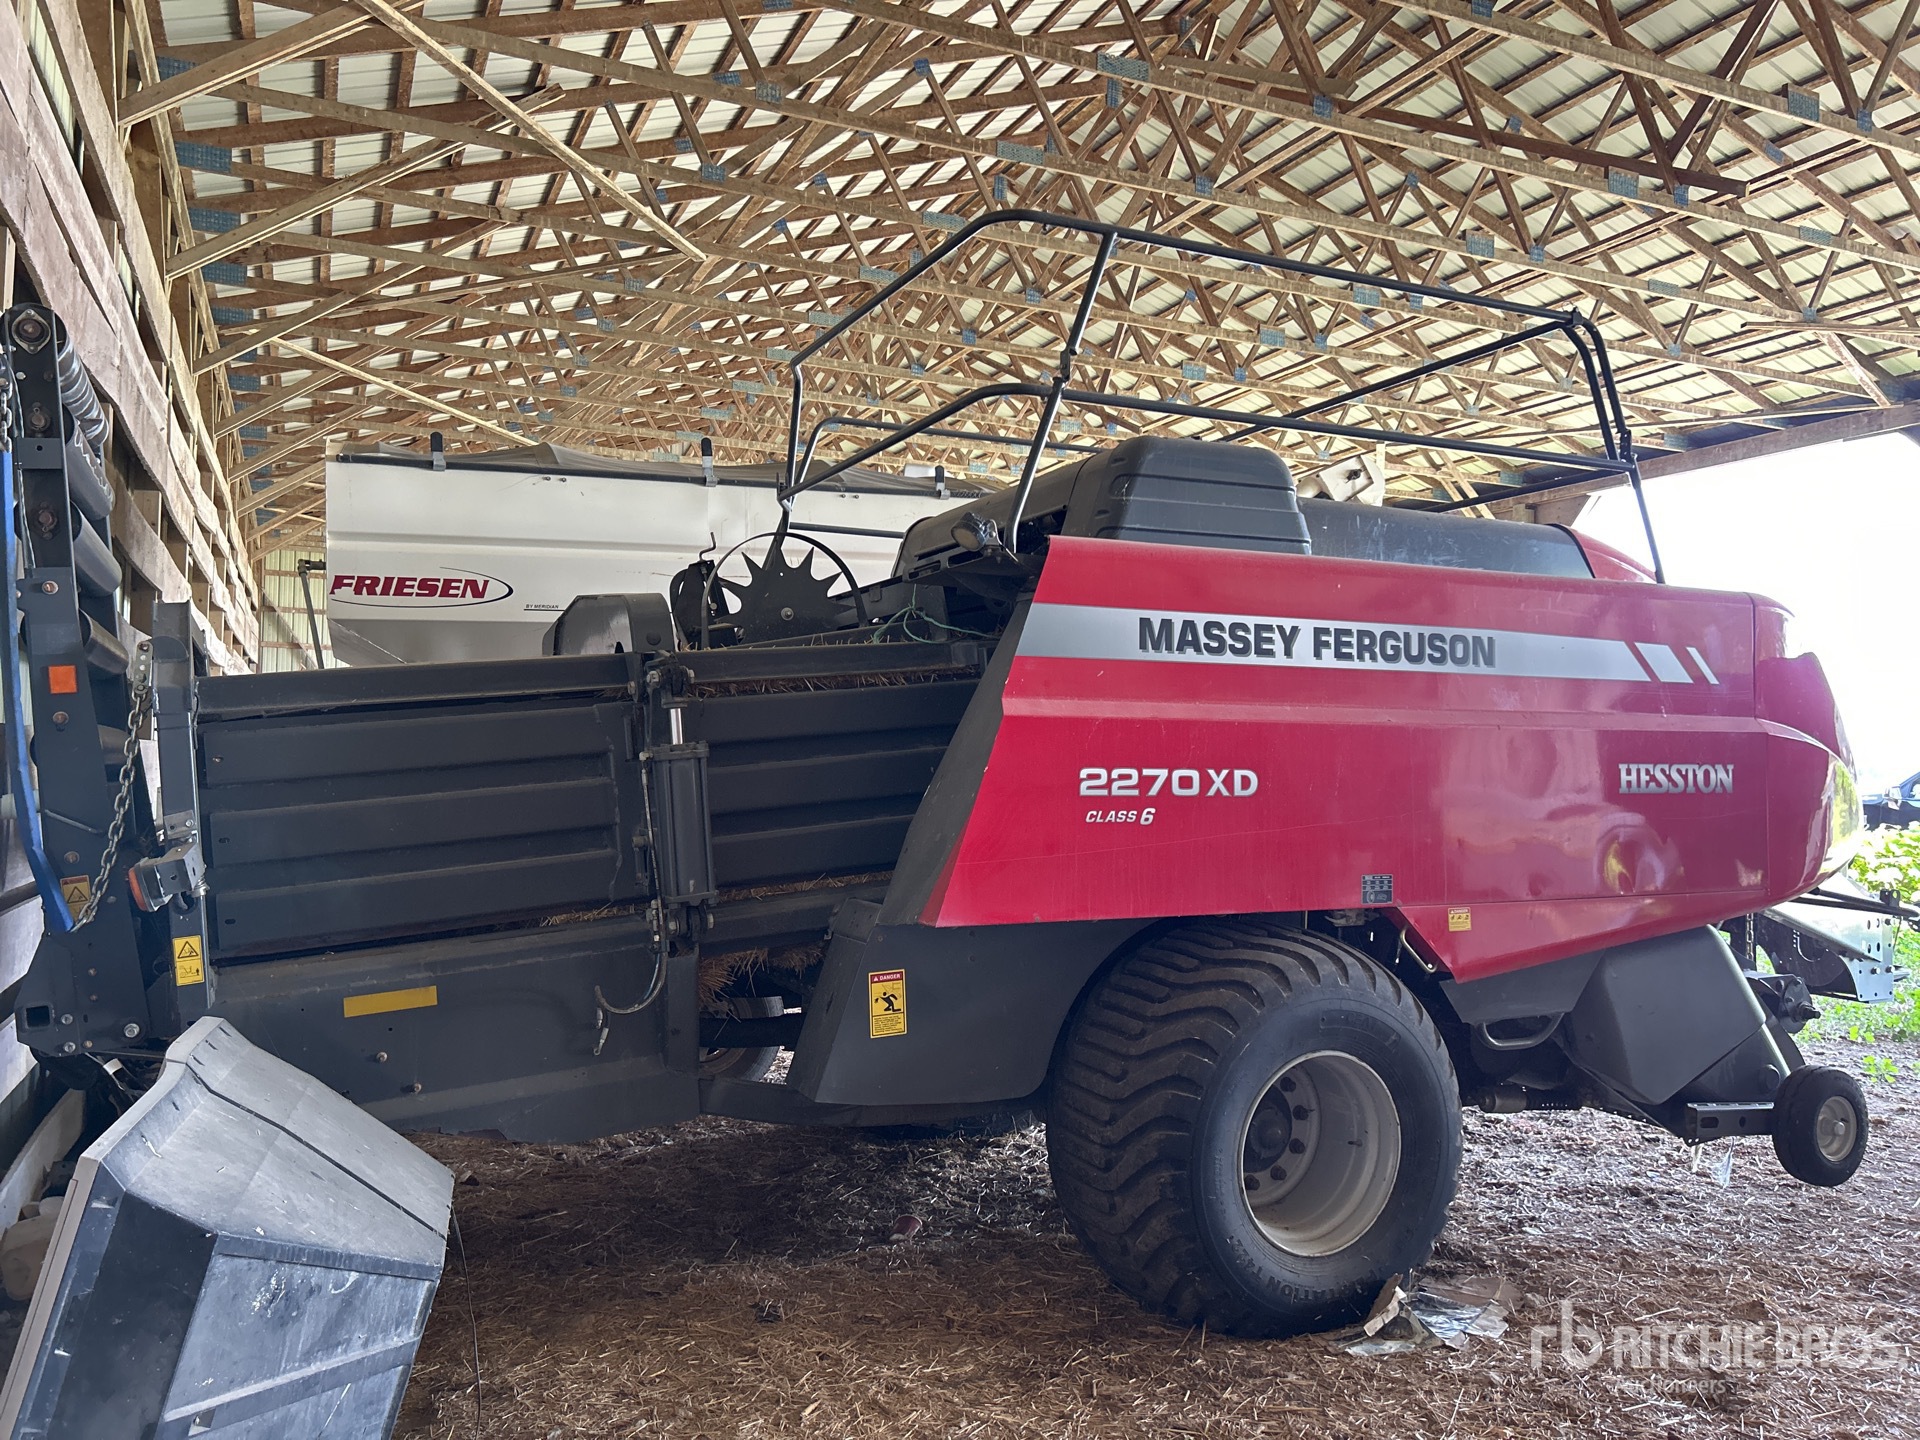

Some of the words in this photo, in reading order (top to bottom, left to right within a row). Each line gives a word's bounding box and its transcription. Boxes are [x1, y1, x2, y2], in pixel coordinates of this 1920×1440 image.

[329, 575, 490, 599] FRIESEN
[1138, 617, 1301, 659] MASSEY
[1313, 626, 1496, 669] FERGUSON
[1079, 767, 1200, 797] 2270
[1205, 768, 1259, 797] XD
[1618, 763, 1735, 794] HESSTON
[1085, 810, 1138, 823] CLASS
[1140, 807, 1156, 825] 6
[879, 973, 901, 981] DANGER
